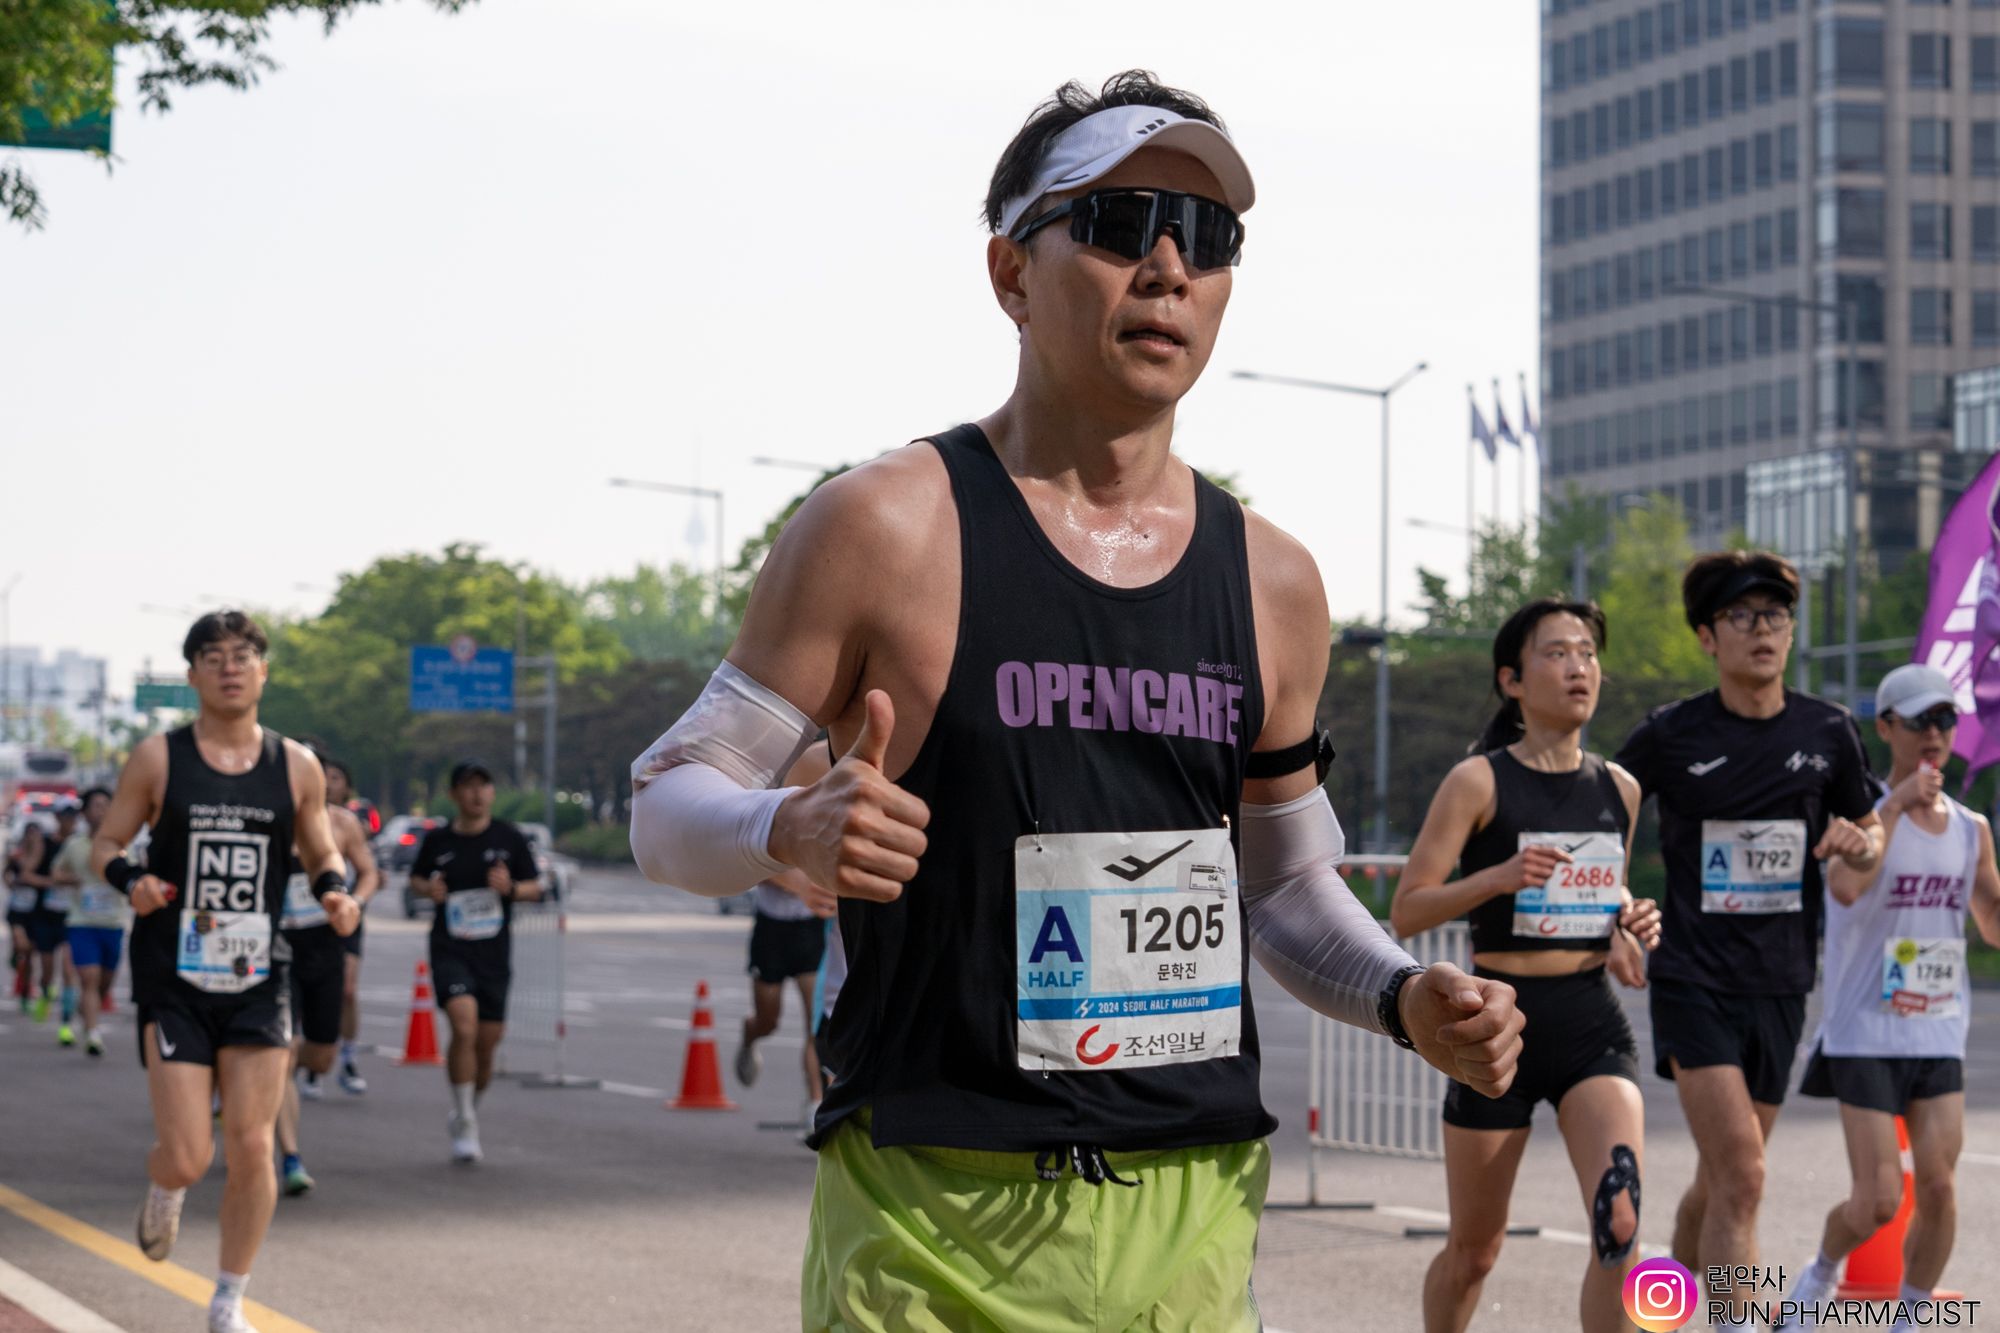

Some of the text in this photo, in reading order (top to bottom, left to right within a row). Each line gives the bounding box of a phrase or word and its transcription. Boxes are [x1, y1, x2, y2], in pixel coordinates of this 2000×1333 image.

[1197, 658, 1223, 674] since
[996, 661, 1244, 748] OPENCARE
[201, 846, 258, 878] NB
[1708, 848, 1728, 870] A
[1744, 850, 1792, 869] 1792
[1560, 864, 1614, 887] 2686
[198, 880, 255, 911] RC
[1028, 906, 1084, 963] A
[1121, 903, 1224, 953] 1205
[218, 936, 258, 953] 3119
[1028, 970, 1084, 988] HALF
[1158, 962, 1197, 980] 문학진
[1888, 962, 1904, 980] A
[1917, 963, 1952, 979] 1784
[1099, 996, 1209, 1013] 2024 SEOUL HALF MARATHON
[1123, 1031, 1206, 1057] 조선일보
